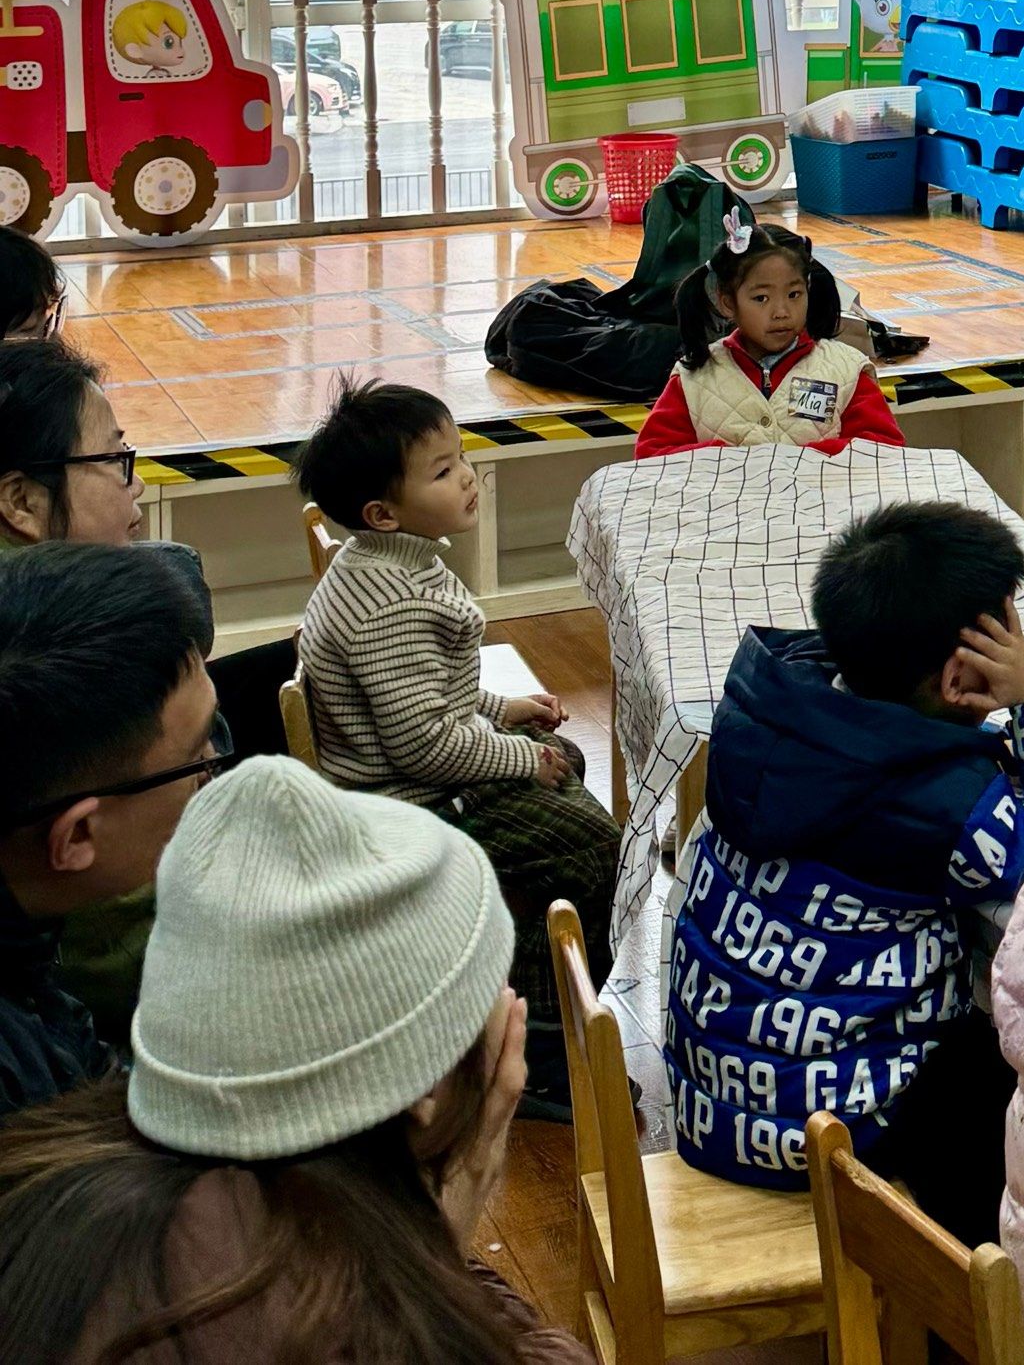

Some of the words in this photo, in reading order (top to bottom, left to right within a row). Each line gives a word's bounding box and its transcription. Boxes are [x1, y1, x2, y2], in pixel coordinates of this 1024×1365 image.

[797, 392, 822, 413] Mia
[711, 890, 827, 991] 1969
[671, 937, 732, 1030] GAP
[684, 1037, 778, 1116] 1969
[734, 1112, 808, 1172] 196
